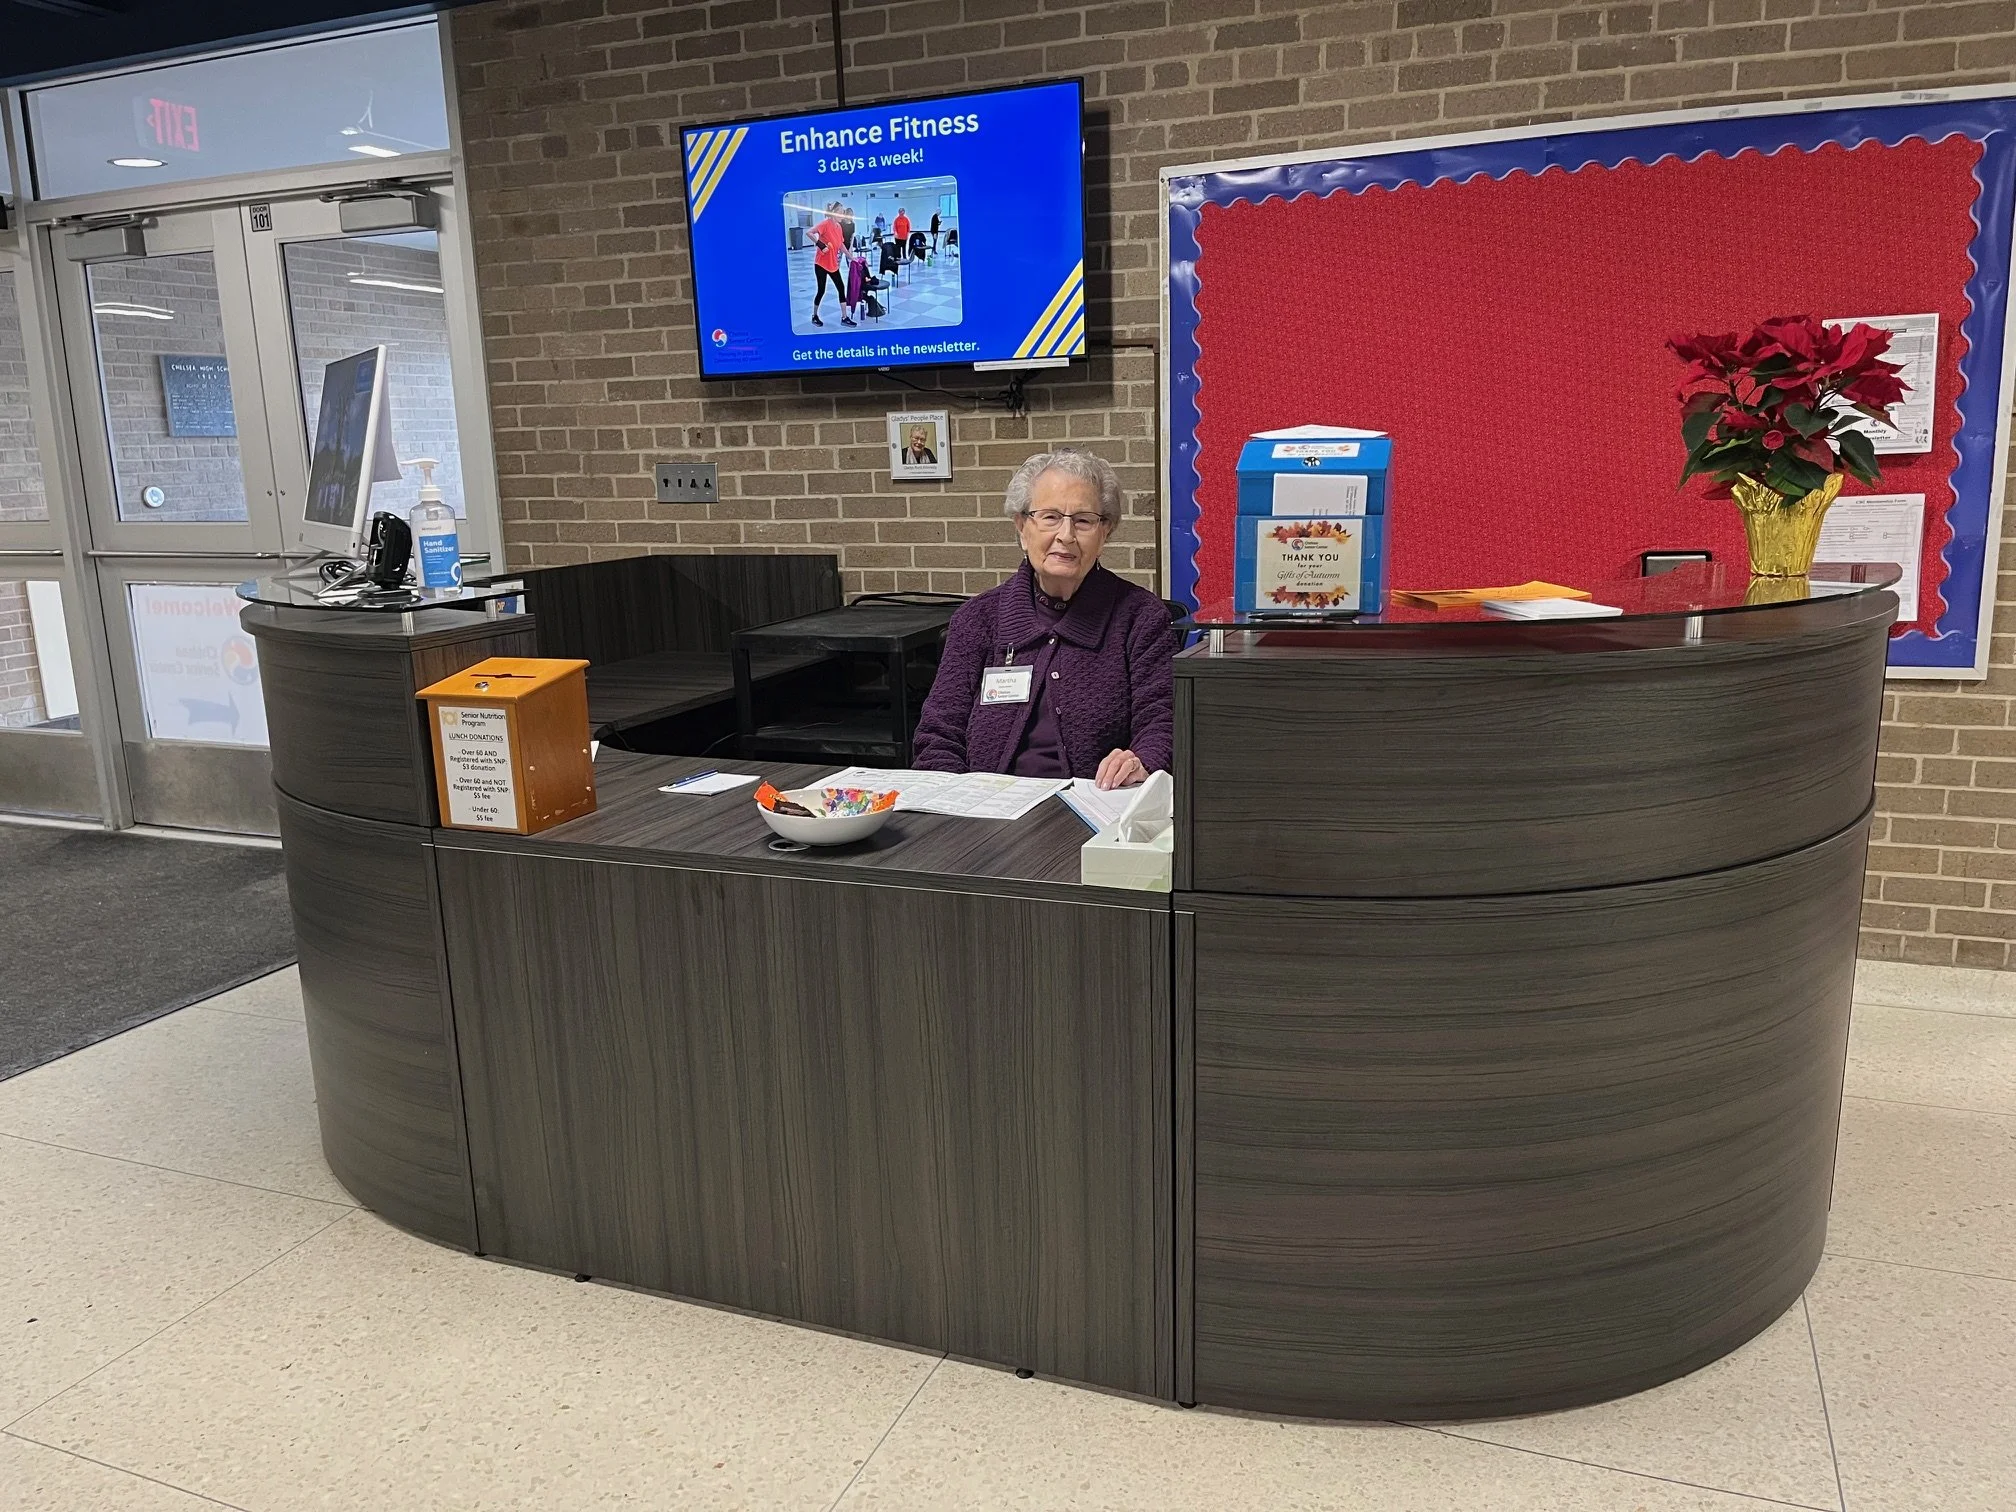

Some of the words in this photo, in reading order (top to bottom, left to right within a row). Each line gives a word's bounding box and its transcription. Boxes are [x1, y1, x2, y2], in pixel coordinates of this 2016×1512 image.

[780, 125, 883, 153] Enhance
[889, 113, 979, 142] Fitness
[817, 159, 827, 173] 3
[830, 156, 865, 174] days
[868, 157, 877, 168] a
[880, 148, 924, 167] week!
[254, 213, 270, 228] 101
[792, 350, 812, 361] Get
[815, 348, 834, 360] the
[836, 345, 875, 359] details
[877, 344, 888, 357] in
[891, 343, 910, 356] the
[913, 341, 980, 355] newsletter.
[1282, 554, 1314, 562] THANK
[1319, 554, 1339, 562] YOU
[1277, 571, 1295, 580] Gifts
[1295, 571, 1305, 580] of
[1304, 571, 1340, 579] Autumn
[480, 712, 505, 720] Nutrition
[469, 734, 504, 742] DONATIONS
[450, 755, 479, 764] Registered
[480, 756, 493, 764] with
[462, 763, 469, 771] $3
[453, 784, 482, 792] Registered
